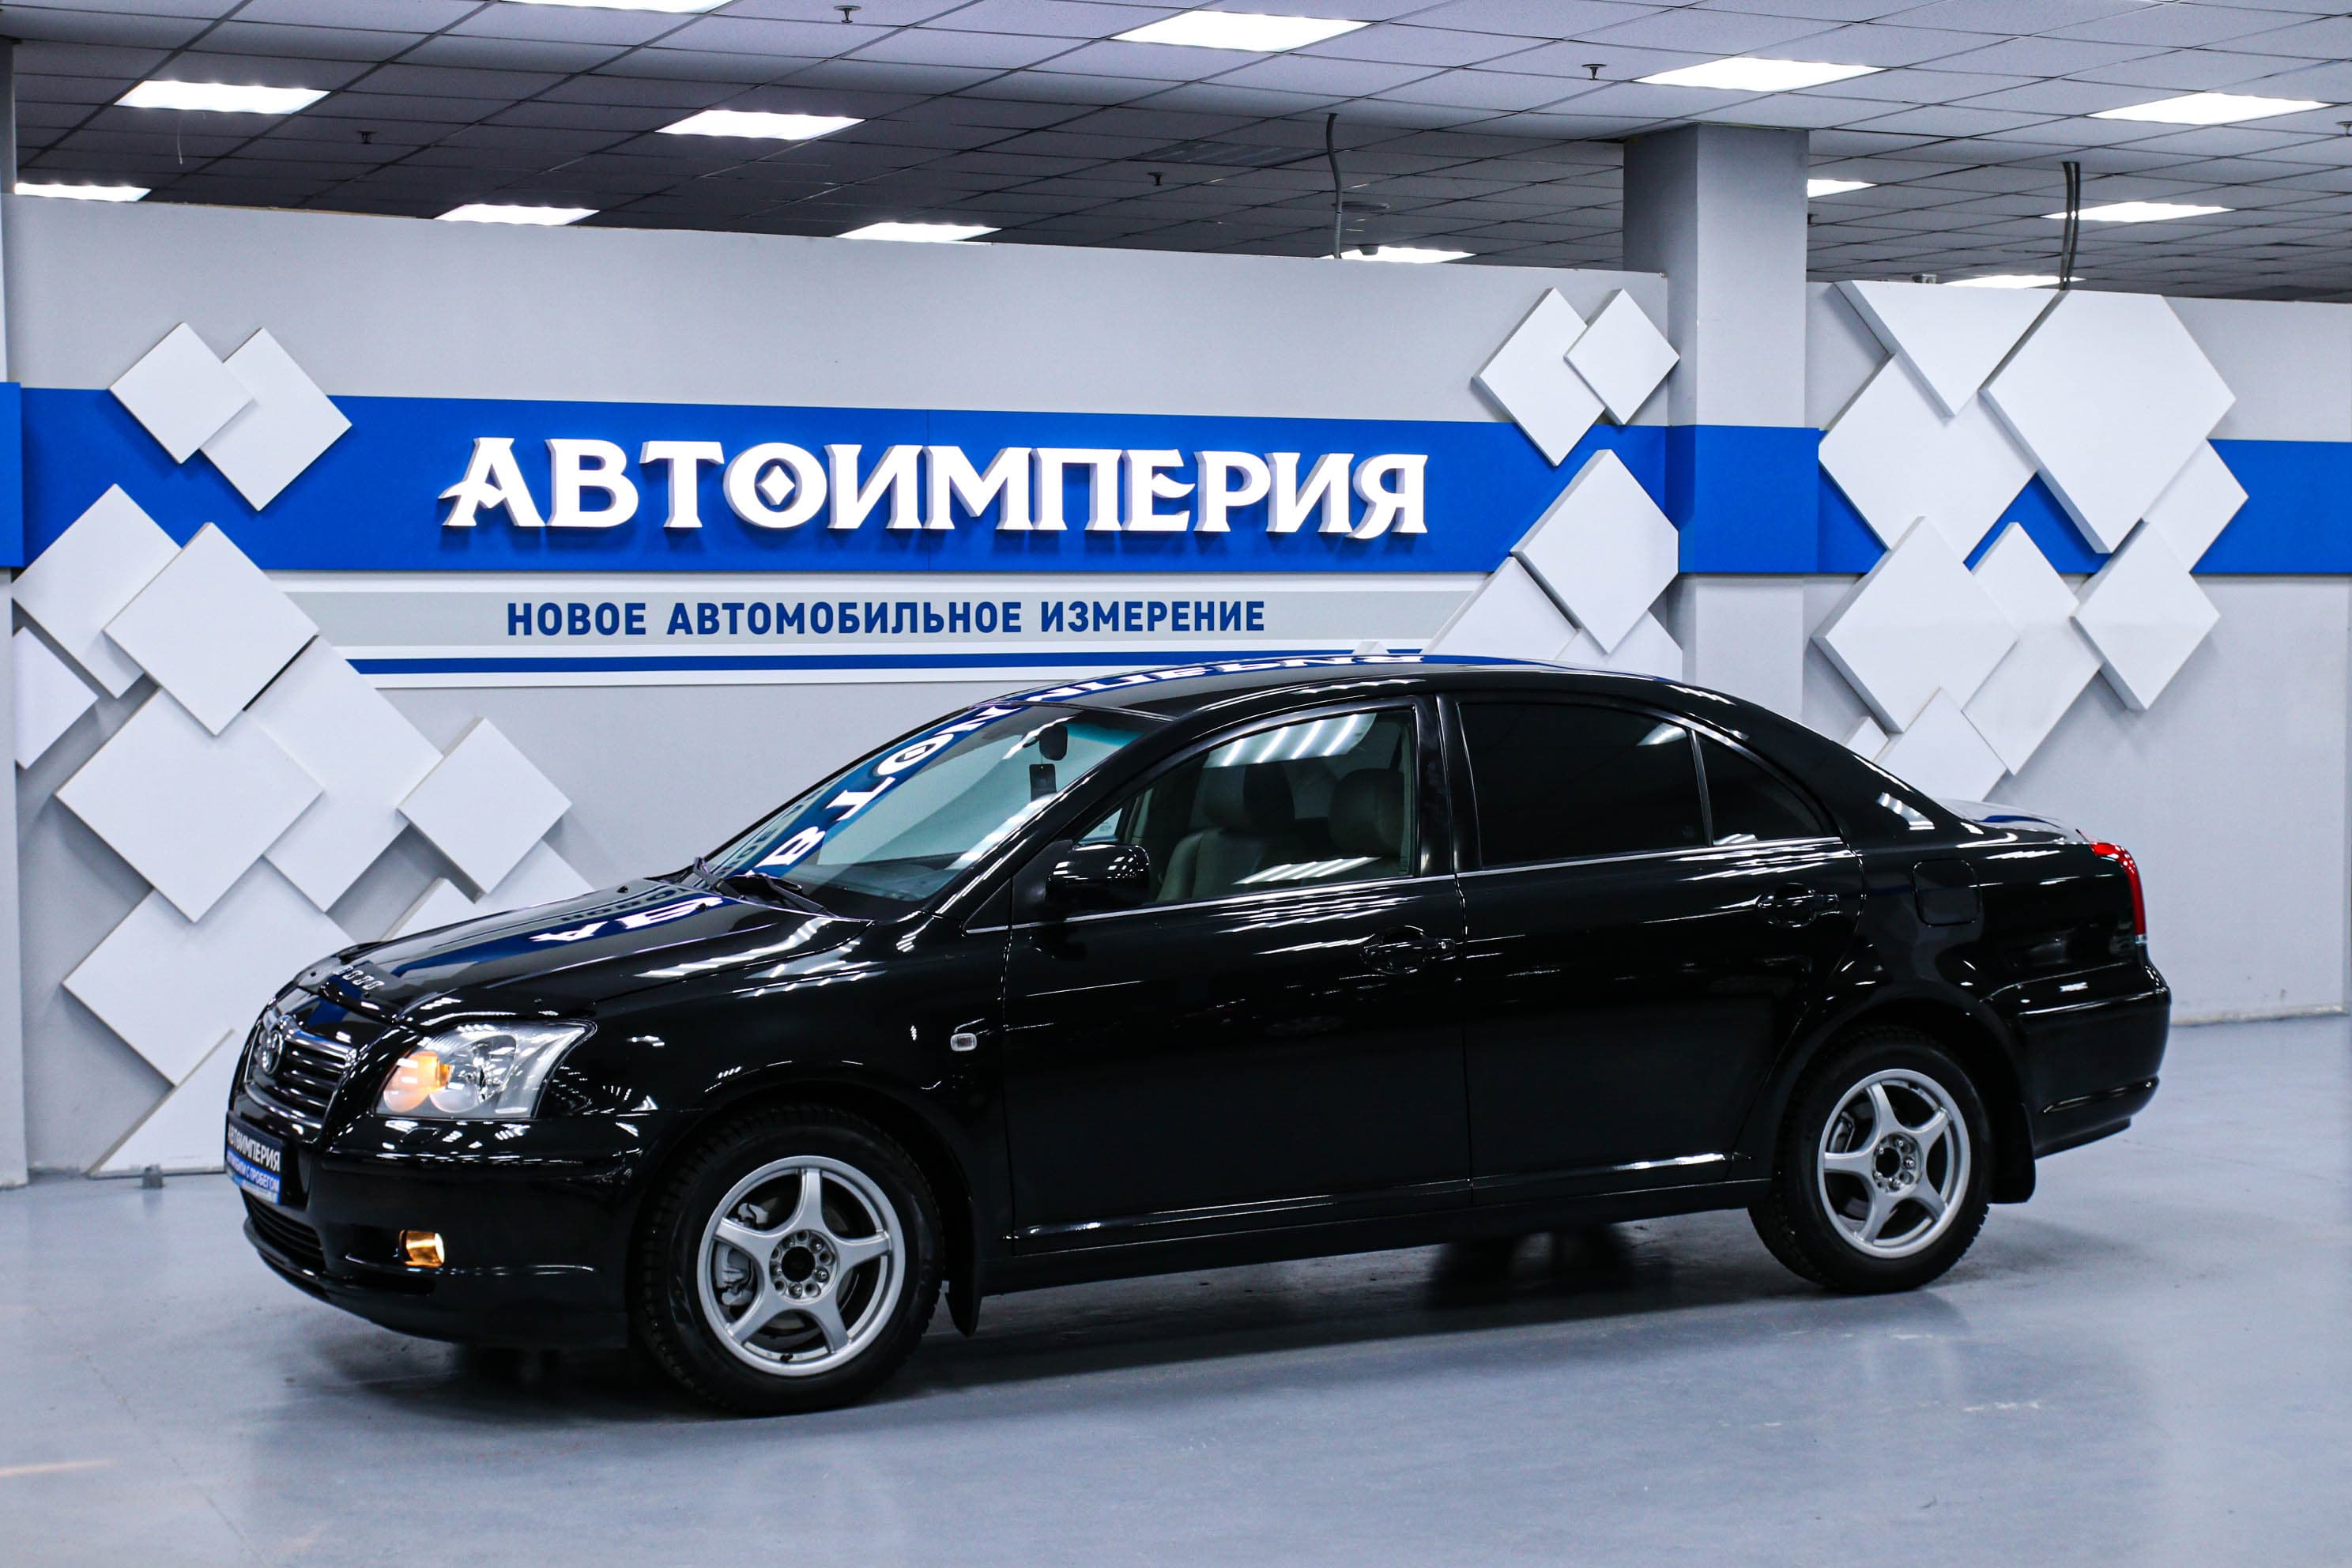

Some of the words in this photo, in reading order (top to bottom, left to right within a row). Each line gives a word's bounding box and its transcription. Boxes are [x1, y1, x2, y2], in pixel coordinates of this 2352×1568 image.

[437, 436, 1429, 539] АВТОИМПЕРИЯ
[508, 602, 645, 635] НОВОЕ
[668, 601, 1021, 635] АВТОМОБИЛЬНОЕ
[1042, 601, 1264, 632] ИЗМЕРЕНИЕ
